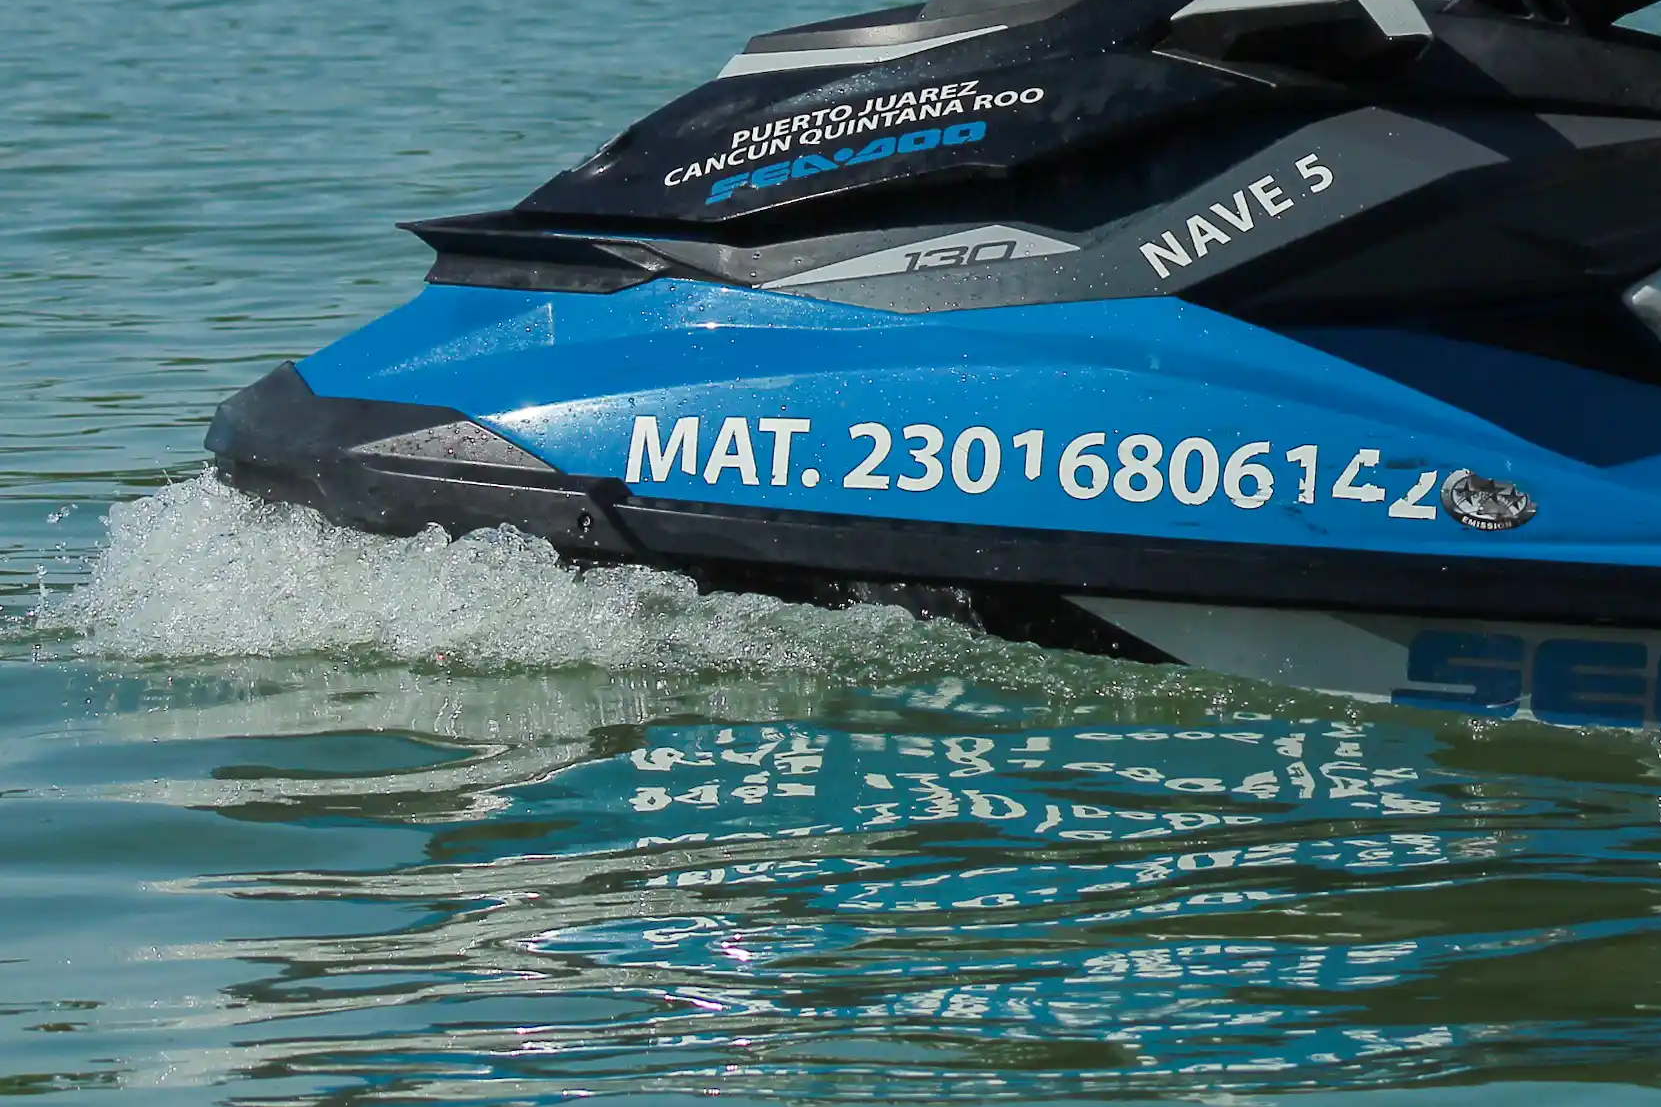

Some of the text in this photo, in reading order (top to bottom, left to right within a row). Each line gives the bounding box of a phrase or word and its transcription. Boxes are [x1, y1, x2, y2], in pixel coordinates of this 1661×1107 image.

[663, 87, 1045, 187] CANCUN QUINTANA ROO
[730, 80, 980, 149] PUERTO JUAREZ
[1139, 152, 1335, 280] NAVE 5
[903, 240, 1018, 272] 130
[625, 415, 820, 488] MAT.
[1461, 515, 1513, 531] EMISSION
